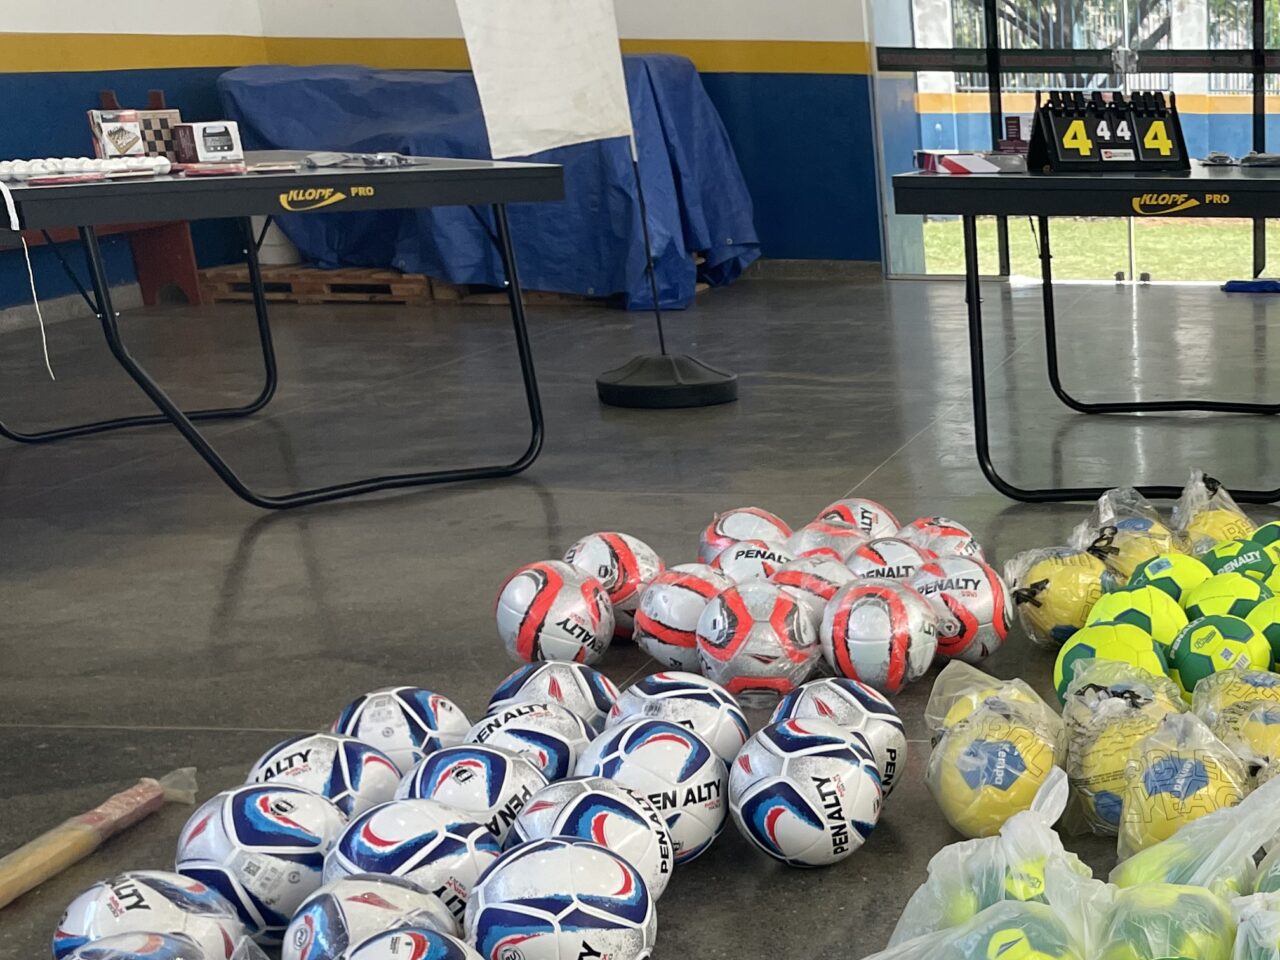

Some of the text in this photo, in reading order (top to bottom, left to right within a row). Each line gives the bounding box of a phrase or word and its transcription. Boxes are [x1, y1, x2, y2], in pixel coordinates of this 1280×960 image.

[1062, 120, 1173, 156] 4 4 4 4
[288, 186, 375, 202] KLOPF PRO
[1140, 193, 1230, 205] KLOPF PRO
[859, 507, 874, 536] ALTY
[735, 549, 792, 564] PENALT
[257, 749, 312, 783] ALTY
[484, 785, 533, 837] PENA
[648, 778, 722, 813] ENALTY
[811, 776, 849, 856] PENALTY
